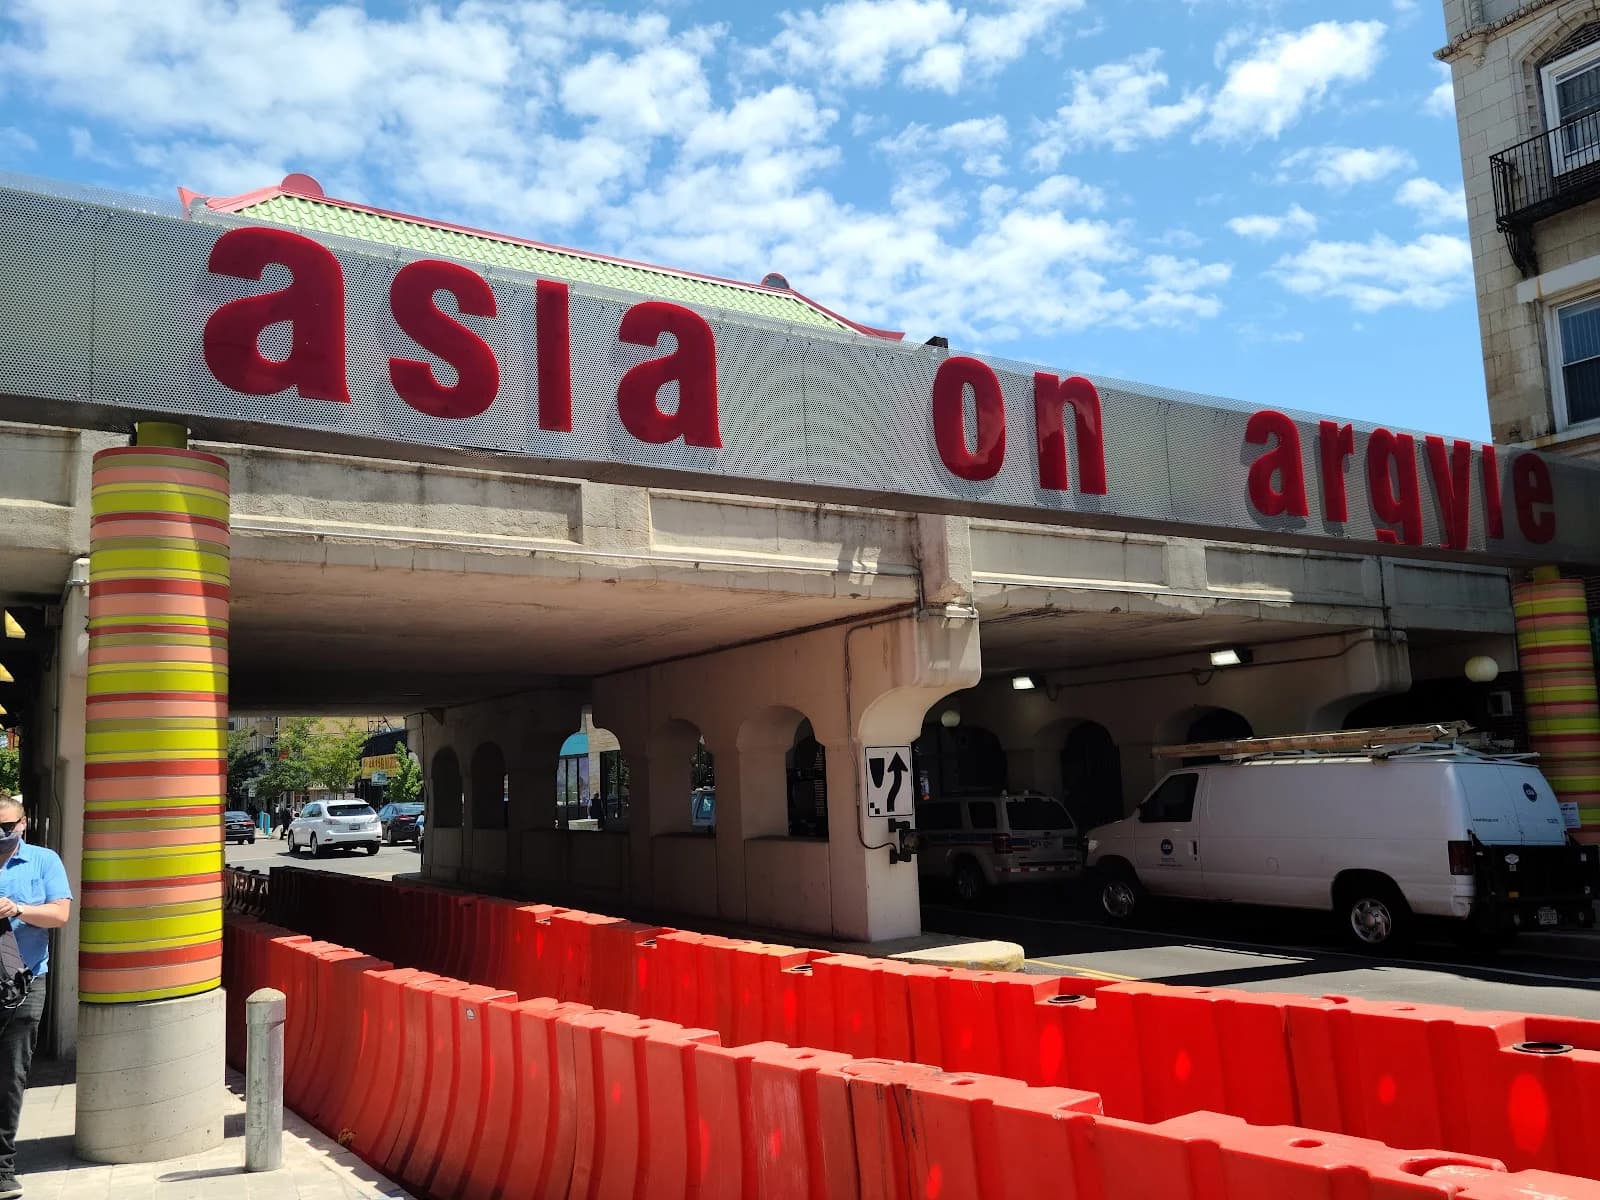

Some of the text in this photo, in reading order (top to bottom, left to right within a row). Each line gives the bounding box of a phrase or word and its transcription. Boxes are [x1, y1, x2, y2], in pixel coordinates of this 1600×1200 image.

[203, 226, 1556, 551] asia on argyle
